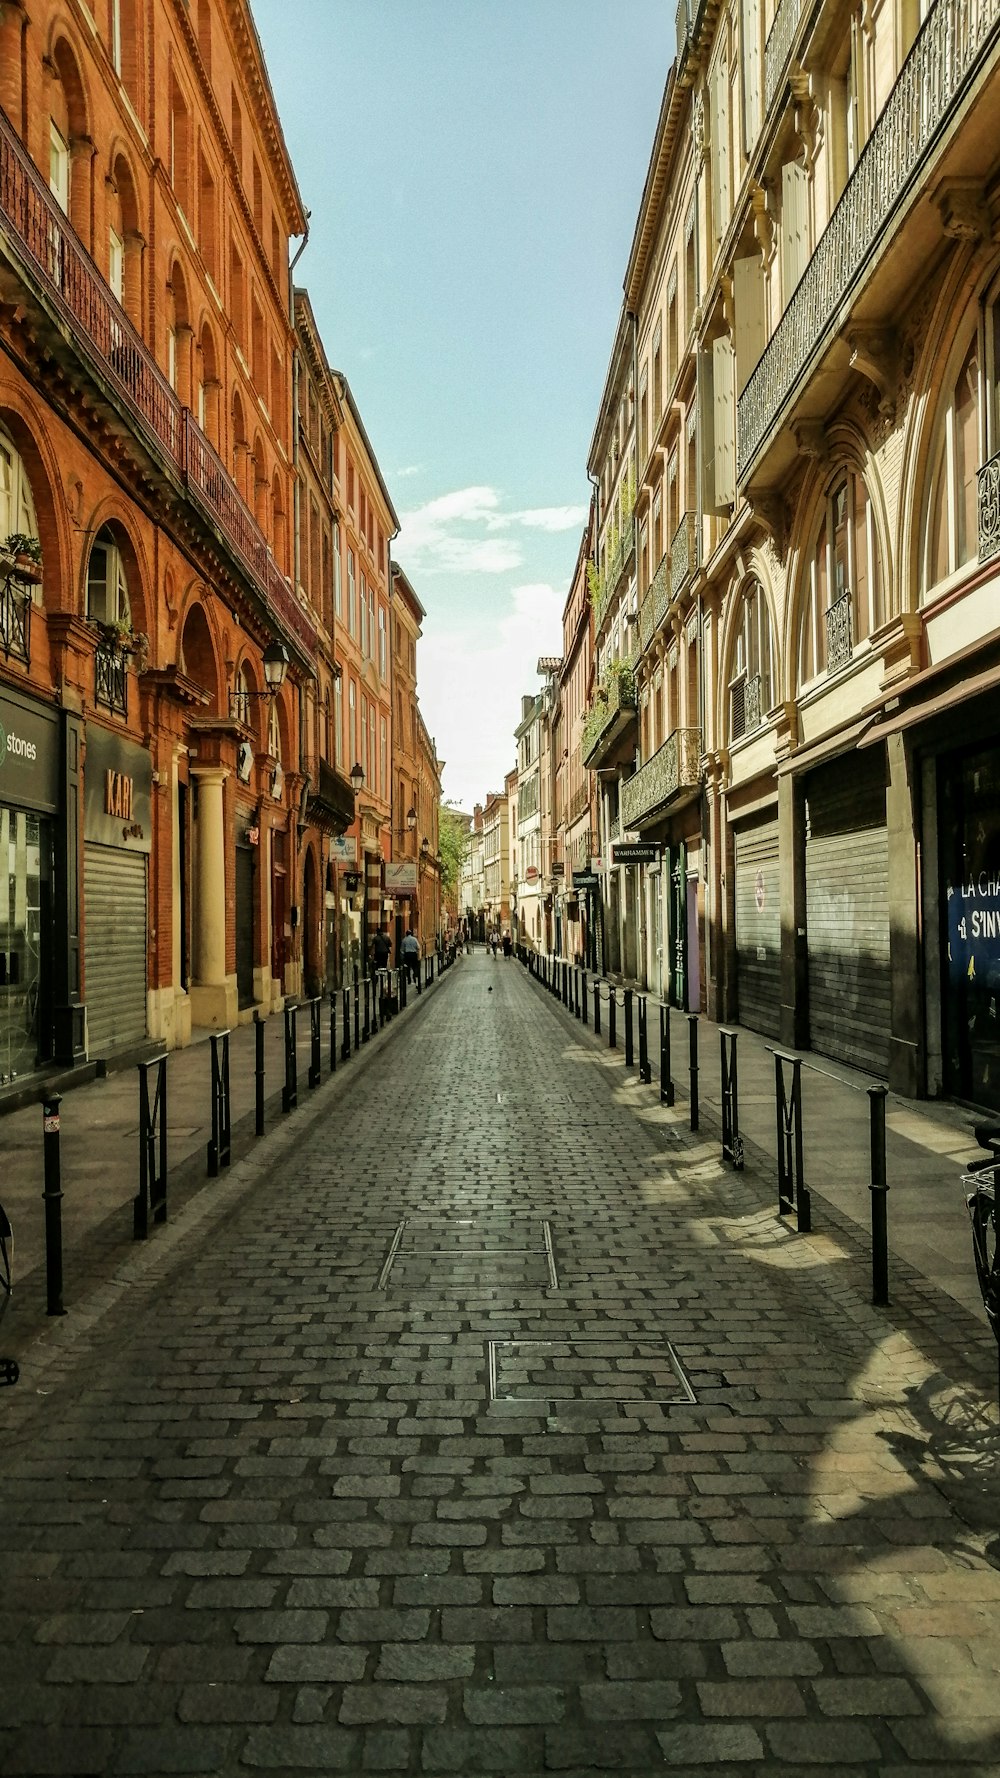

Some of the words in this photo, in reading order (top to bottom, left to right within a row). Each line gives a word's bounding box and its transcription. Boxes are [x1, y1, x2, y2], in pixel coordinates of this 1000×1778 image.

[6, 732, 37, 760] stones
[106, 768, 134, 821] KARL
[614, 849, 654, 857] WARHAMMER
[961, 872, 976, 898] LA
